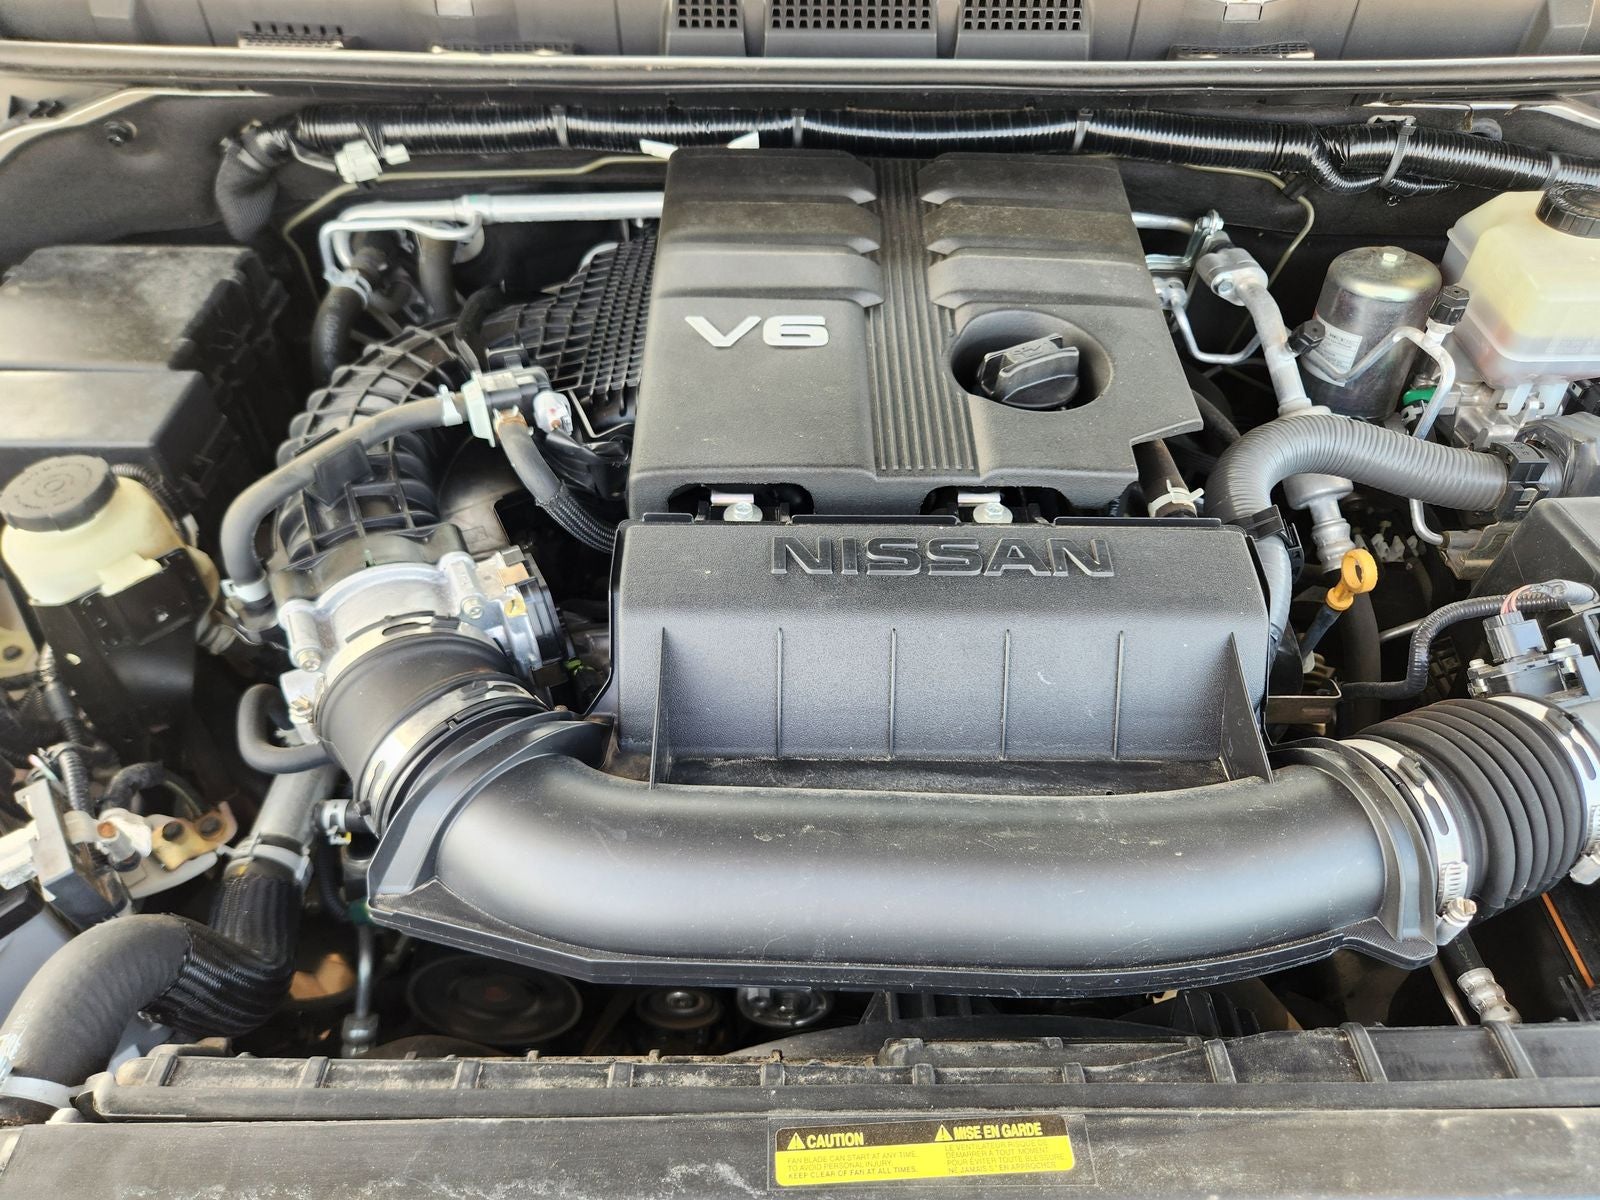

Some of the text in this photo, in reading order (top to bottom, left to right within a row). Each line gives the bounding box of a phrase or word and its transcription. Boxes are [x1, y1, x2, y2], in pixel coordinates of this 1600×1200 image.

[684, 315, 830, 348] V6
[770, 536, 1115, 577] NISSAN
[953, 1122, 1043, 1140] MISE EN GARDE
[806, 1132, 864, 1149] CAUTION
[829, 1154, 845, 1162] CAN
[848, 1153, 870, 1161] START
[882, 1151, 896, 1159] ANY
[800, 1163, 822, 1171] AVOID
[824, 1161, 864, 1170] PERSONAL
[810, 1170, 835, 1178] CLEAR
